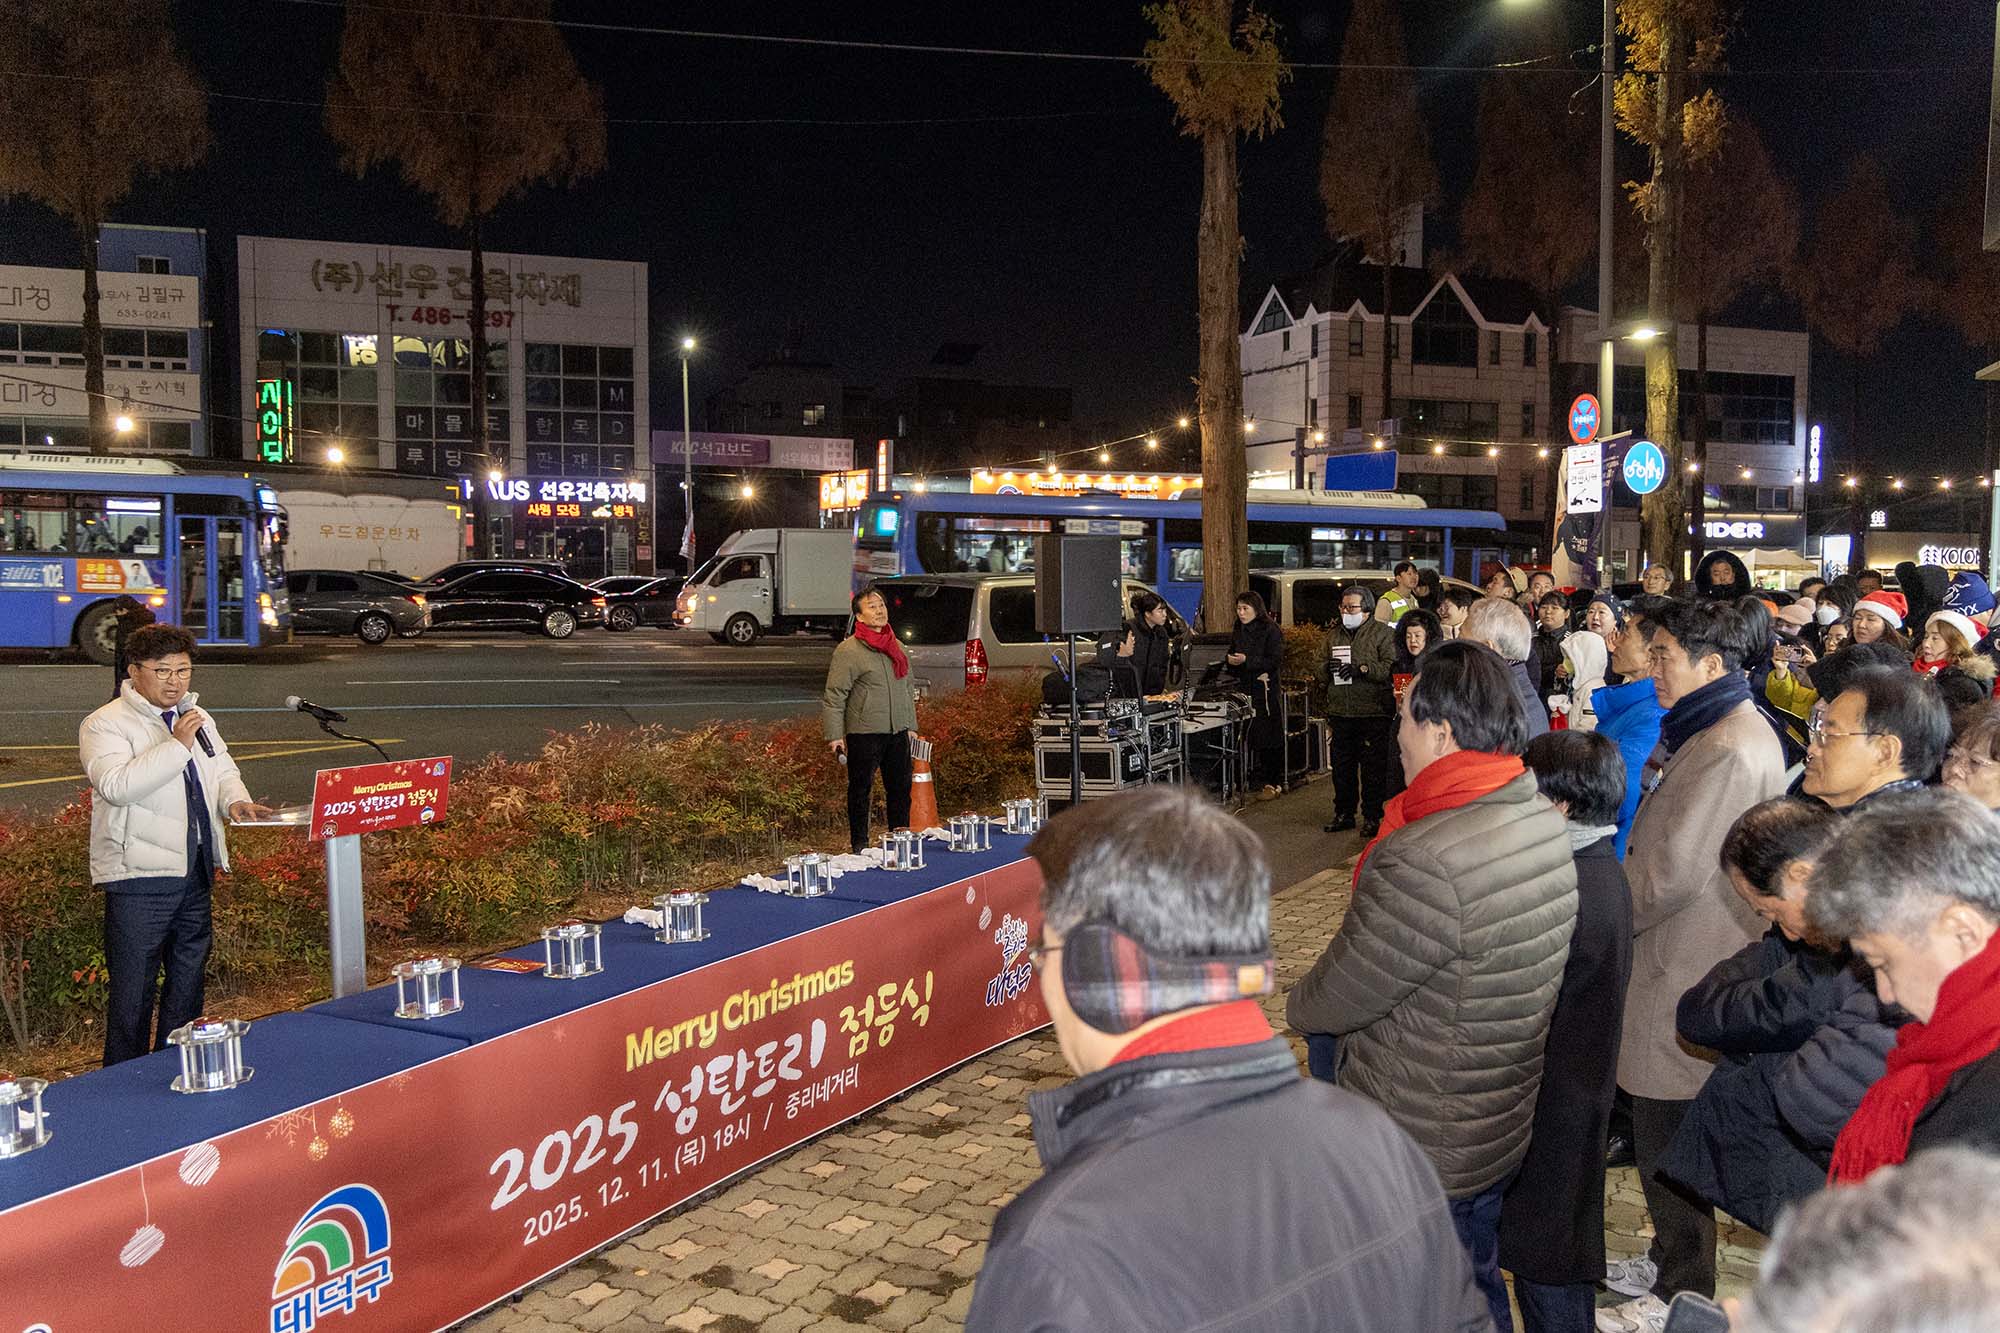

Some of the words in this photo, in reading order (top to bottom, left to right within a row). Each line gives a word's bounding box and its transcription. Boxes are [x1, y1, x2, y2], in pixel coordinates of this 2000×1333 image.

[136, 286, 186, 304] 김필규
[1688, 521, 1764, 539] IDER
[323, 800, 356, 817] 2025
[358, 793, 405, 814] 성탄트리
[407, 788, 439, 807] 점등식
[625, 1015, 718, 1074] Merry
[722, 959, 855, 1033] Christmas
[488, 1100, 638, 1212] 2025
[654, 1018, 827, 1136] 성탄트리
[840, 971, 935, 1059] 점등식
[523, 1198, 590, 1247] 2025.
[598, 1175, 629, 1210] 12.
[638, 1159, 669, 1189] 11.
[674, 1135, 707, 1176] (목)
[713, 1113, 751, 1153] 18시
[784, 1062, 861, 1120] 중리네거리
[271, 1255, 393, 1333] 대덕구
